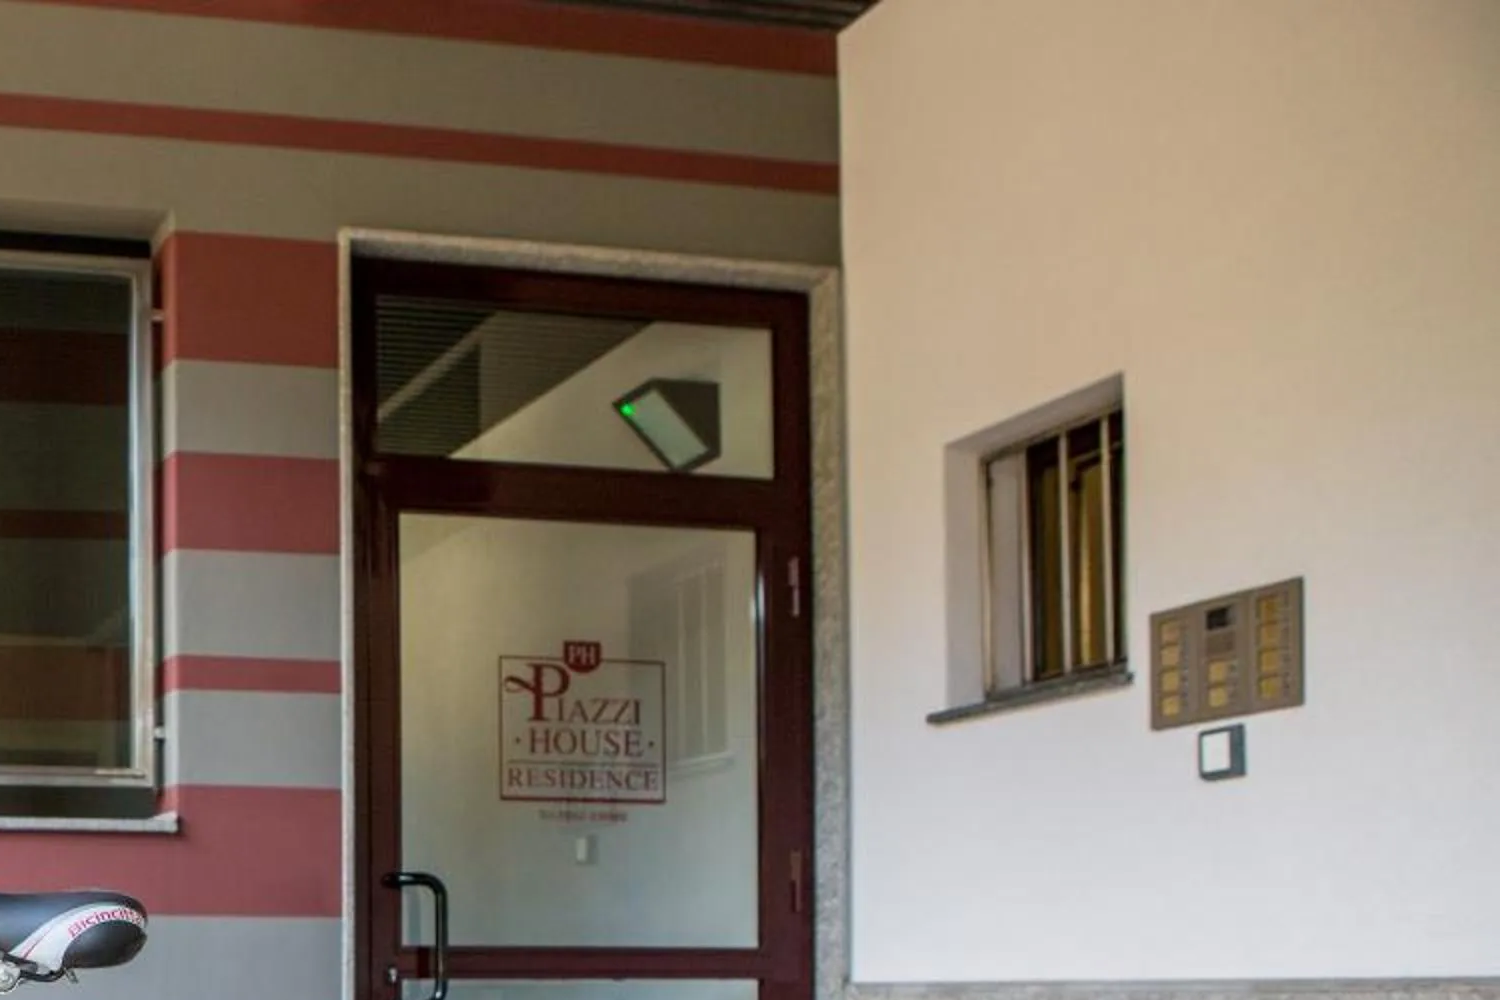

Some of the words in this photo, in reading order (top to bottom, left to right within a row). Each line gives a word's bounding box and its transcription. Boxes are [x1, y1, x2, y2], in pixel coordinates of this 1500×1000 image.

[568, 643, 597, 667] PH
[529, 727, 644, 758] HOUSE
[507, 767, 659, 792] RESIDENCE
